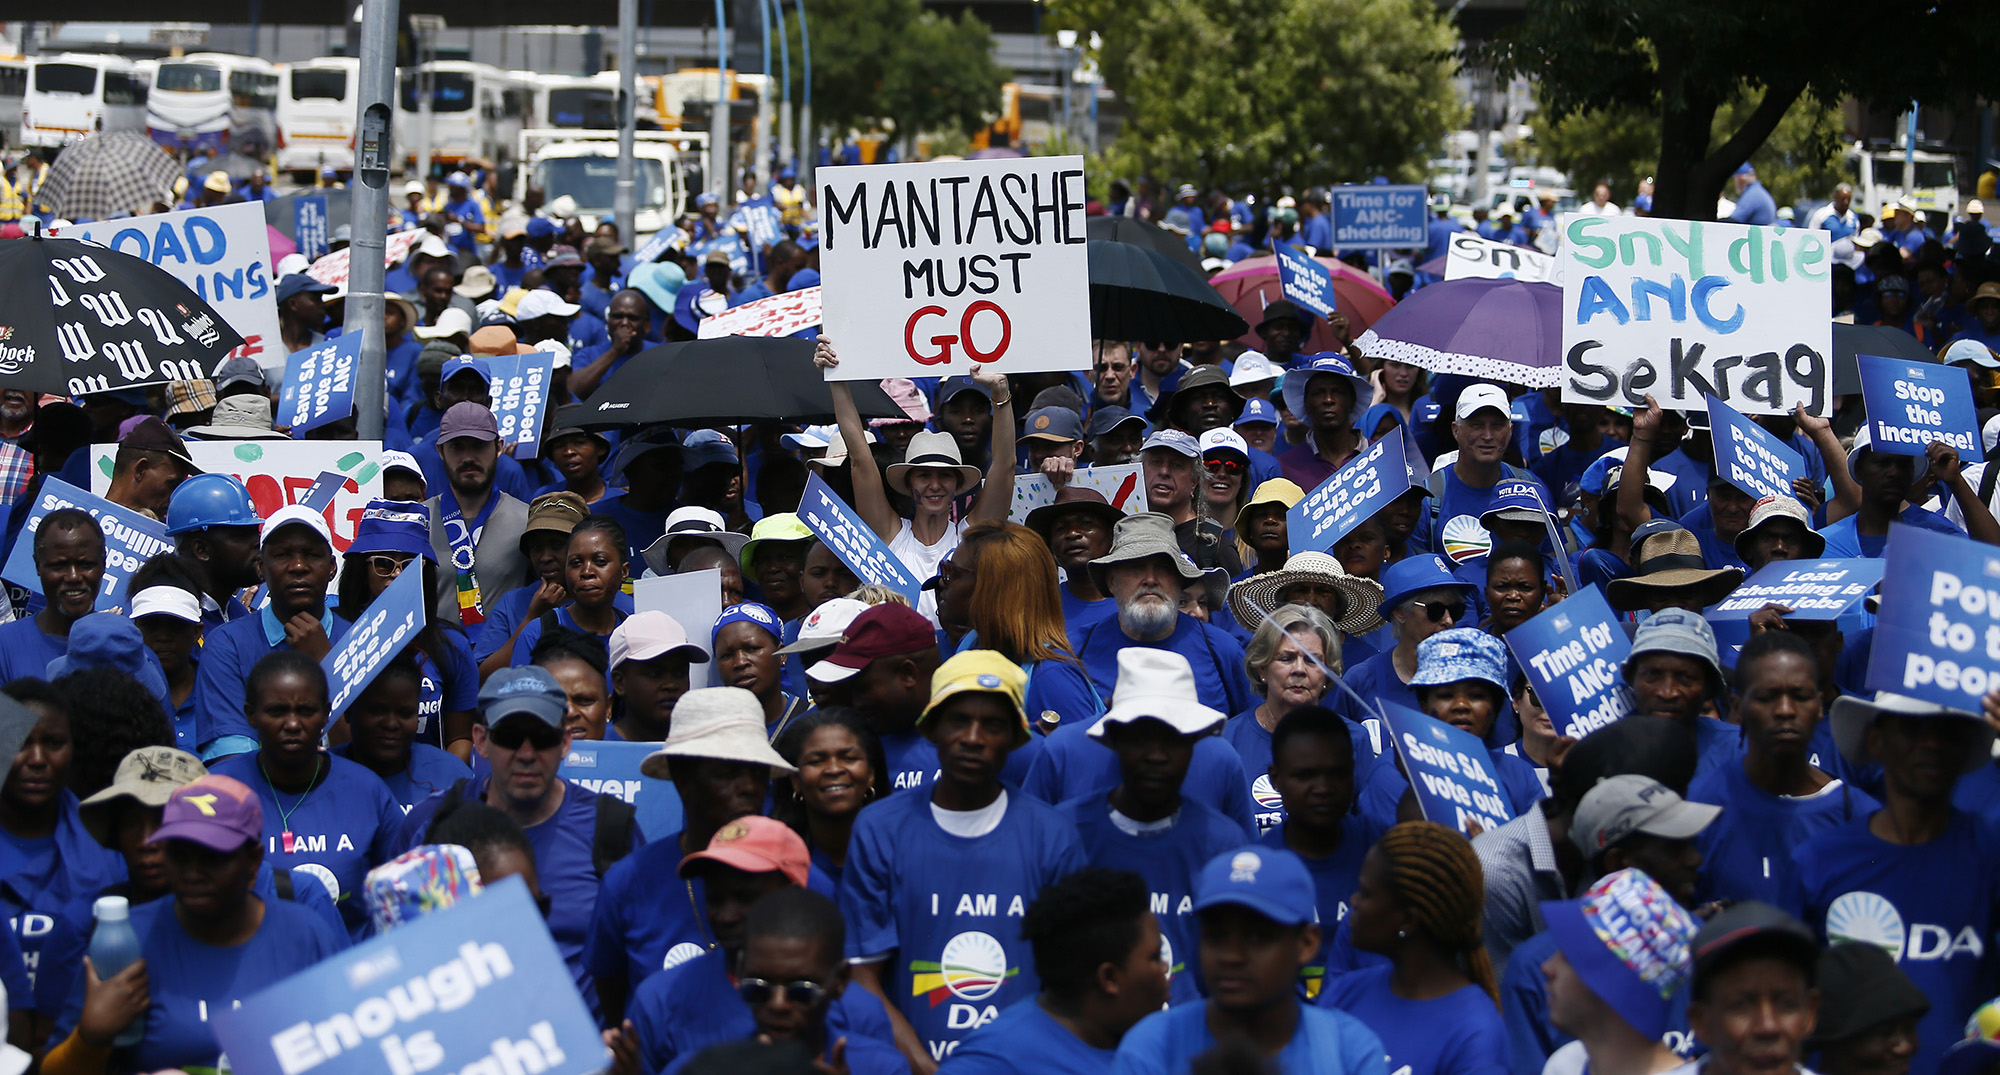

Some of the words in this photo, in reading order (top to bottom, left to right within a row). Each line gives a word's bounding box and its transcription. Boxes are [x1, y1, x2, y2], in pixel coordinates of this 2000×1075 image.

[824, 170, 1085, 251] MANTASHE
[1338, 193, 1384, 208] Time
[1388, 192, 1416, 207] for
[1355, 209, 1404, 224] ANC-
[1337, 225, 1422, 241] shedding
[1567, 217, 1704, 281] Sny
[1729, 224, 1828, 284] die
[904, 252, 1031, 299] MUST
[1279, 253, 1309, 278] Time
[1311, 268, 1327, 288] for
[1294, 274, 1323, 296] ANC-
[1577, 274, 1745, 335] ANC
[904, 299, 1011, 365] GO
[298, 350, 321, 383] SA,
[321, 345, 338, 375] out
[332, 354, 353, 393] ANC
[292, 383, 313, 427] Save
[315, 375, 331, 419] vote
[502, 376, 523, 411] the
[518, 367, 544, 443] people!
[1894, 380, 1945, 407] Stop
[500, 414, 516, 437] to
[1905, 404, 1942, 426] the
[1226, 435, 1237, 444] DA
[1730, 423, 1789, 475] Power
[1878, 421, 1975, 451] increase!
[1303, 442, 1384, 517] people!
[1353, 467, 1377, 489] to
[1735, 445, 1756, 470] to
[1760, 461, 1791, 494] the
[1312, 488, 1348, 521] the
[1498, 487, 1512, 496] VOTE
[1513, 484, 1536, 495] DA
[818, 489, 871, 550] Time
[876, 551, 908, 586] for
[832, 524, 891, 582] ANC-
[1731, 583, 1842, 598] shedding
[1840, 583, 1867, 596] is
[1782, 569, 1849, 582] Load
[1792, 596, 1846, 609] jobs
[333, 609, 387, 675] Stop
[1928, 611, 1975, 652] to
[329, 611, 414, 717] crease!
[341, 636, 380, 682] the
[1530, 640, 1586, 683] Time
[1579, 621, 1613, 654] for
[1568, 658, 1618, 705] ANC-
[894, 771, 923, 788] AM
[1403, 732, 1460, 774] Save
[1456, 752, 1498, 793] SA,
[1419, 771, 1472, 807] vote
[1472, 790, 1510, 820] out
[270, 837, 275, 853] I
[293, 834, 327, 854] AM
[336, 834, 354, 852] A
[931, 893, 939, 916] I
[955, 894, 997, 916] AM
[1007, 895, 1025, 917] A
[1150, 893, 1169, 914] M
[1907, 923, 1984, 961] DA
[271, 940, 514, 1075] Enough
[947, 1003, 999, 1029] DA
[380, 1029, 445, 1075] is
